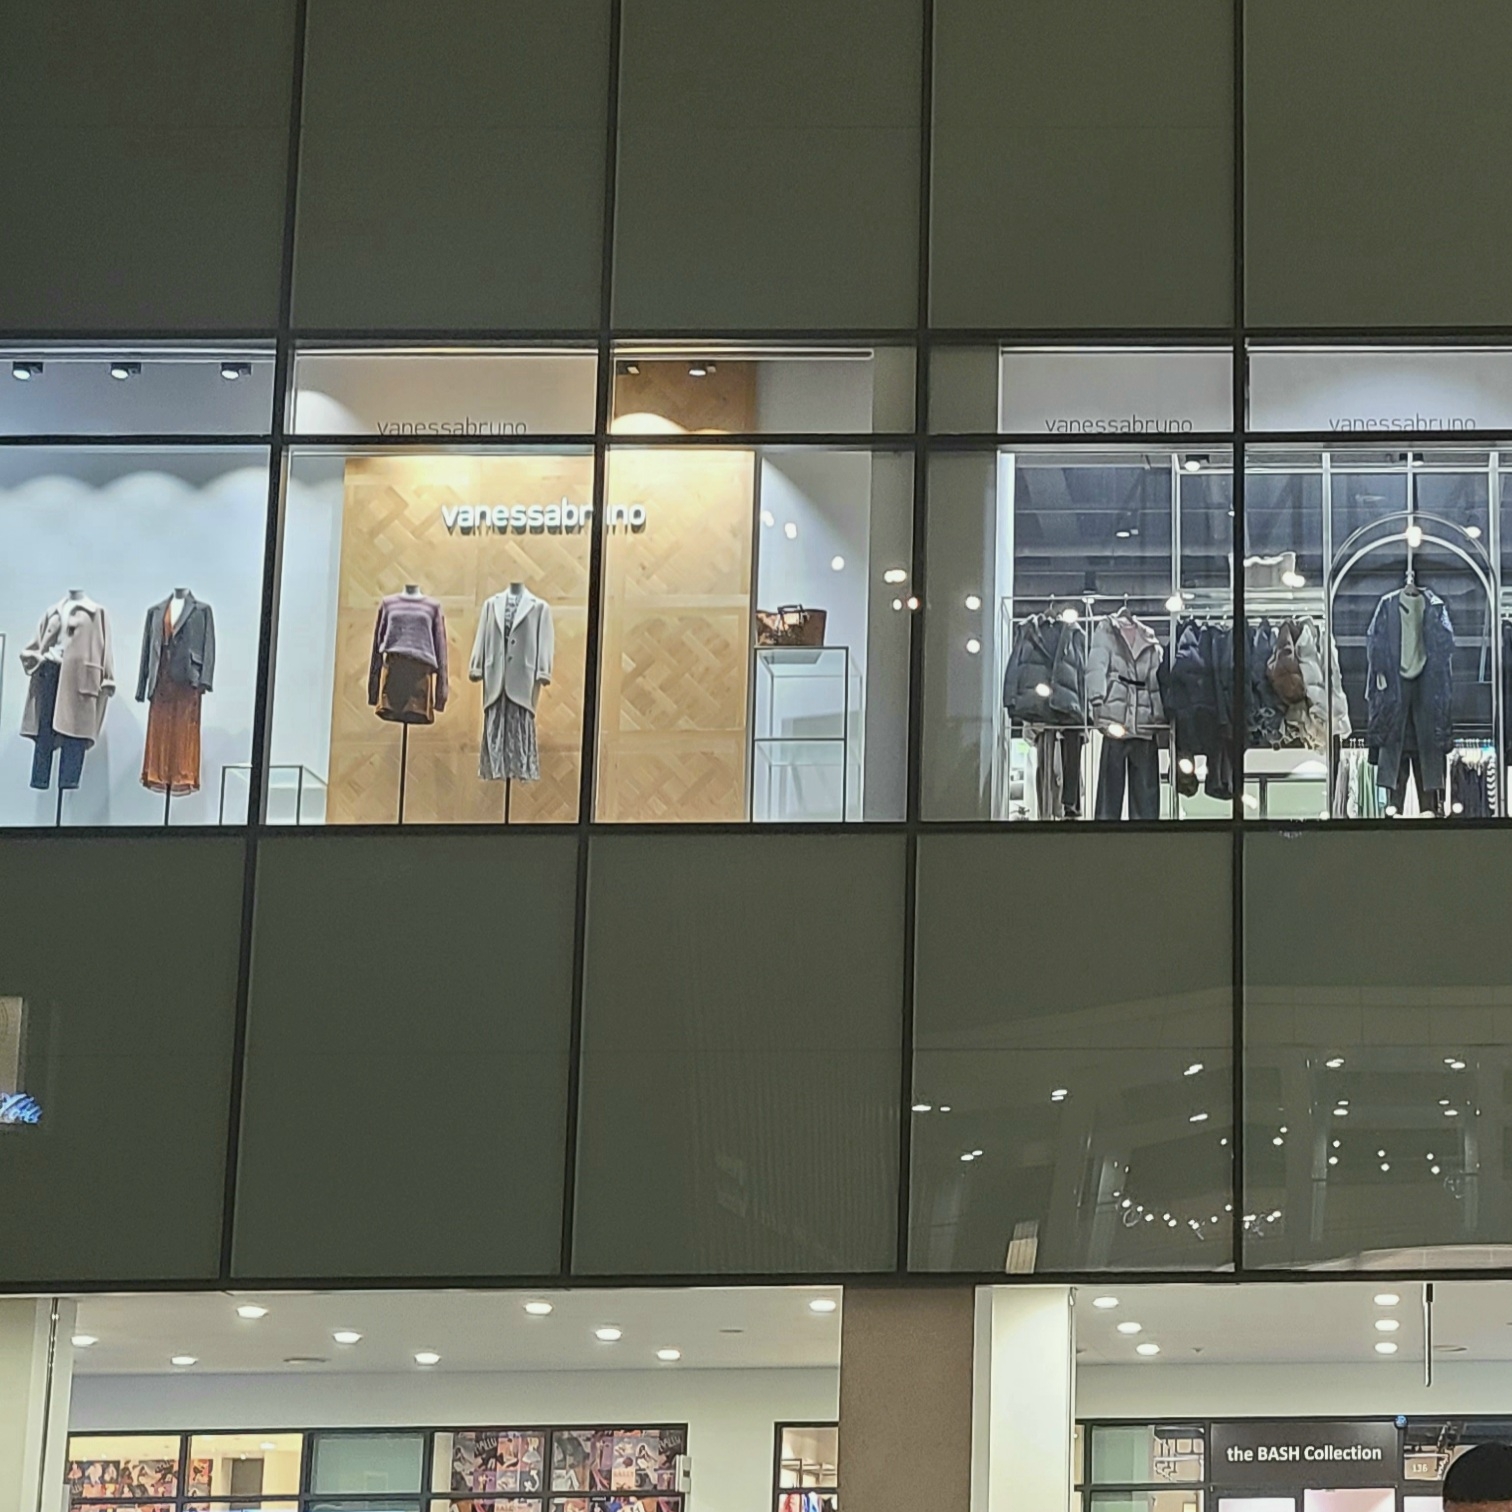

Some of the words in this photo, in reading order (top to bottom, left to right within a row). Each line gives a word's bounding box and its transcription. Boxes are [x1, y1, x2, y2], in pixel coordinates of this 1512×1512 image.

[377, 416, 527, 436] vanessabruno
[1045, 414, 1193, 433] vanessabruno
[1327, 413, 1476, 431] vanessabruno
[1226, 1445, 1254, 1462] the
[1257, 1446, 1300, 1461] BASH
[1303, 1444, 1382, 1461] Collection
